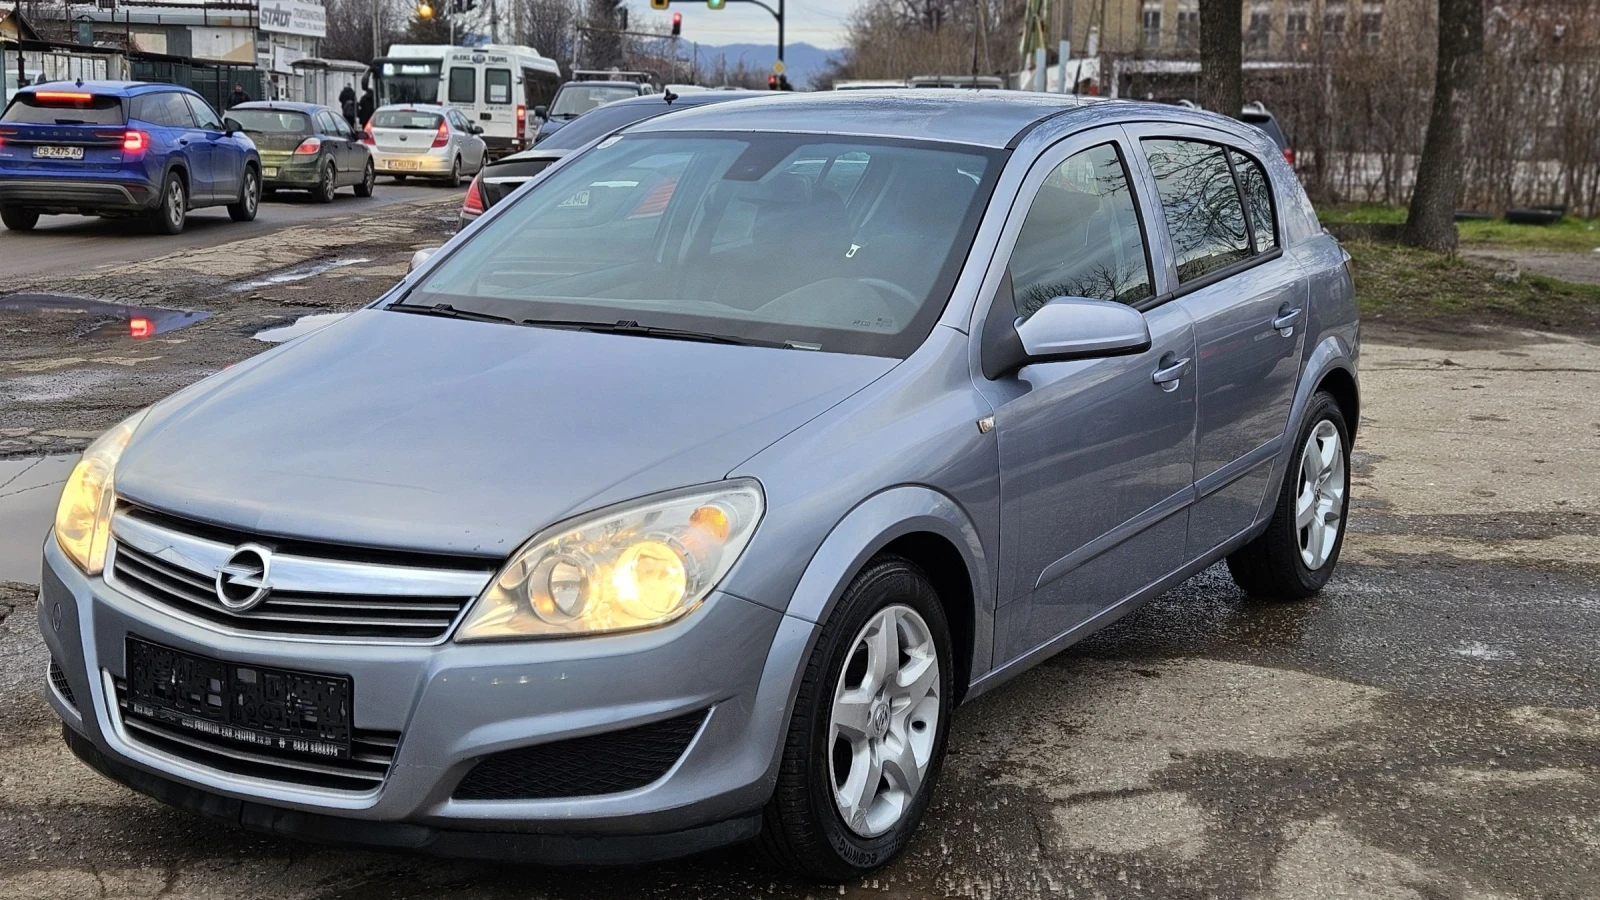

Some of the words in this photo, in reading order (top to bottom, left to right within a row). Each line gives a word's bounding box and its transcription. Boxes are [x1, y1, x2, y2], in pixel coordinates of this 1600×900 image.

[487, 55, 508, 63] TRANS
[38, 147, 49, 155] CB
[50, 147, 70, 156] 2475
